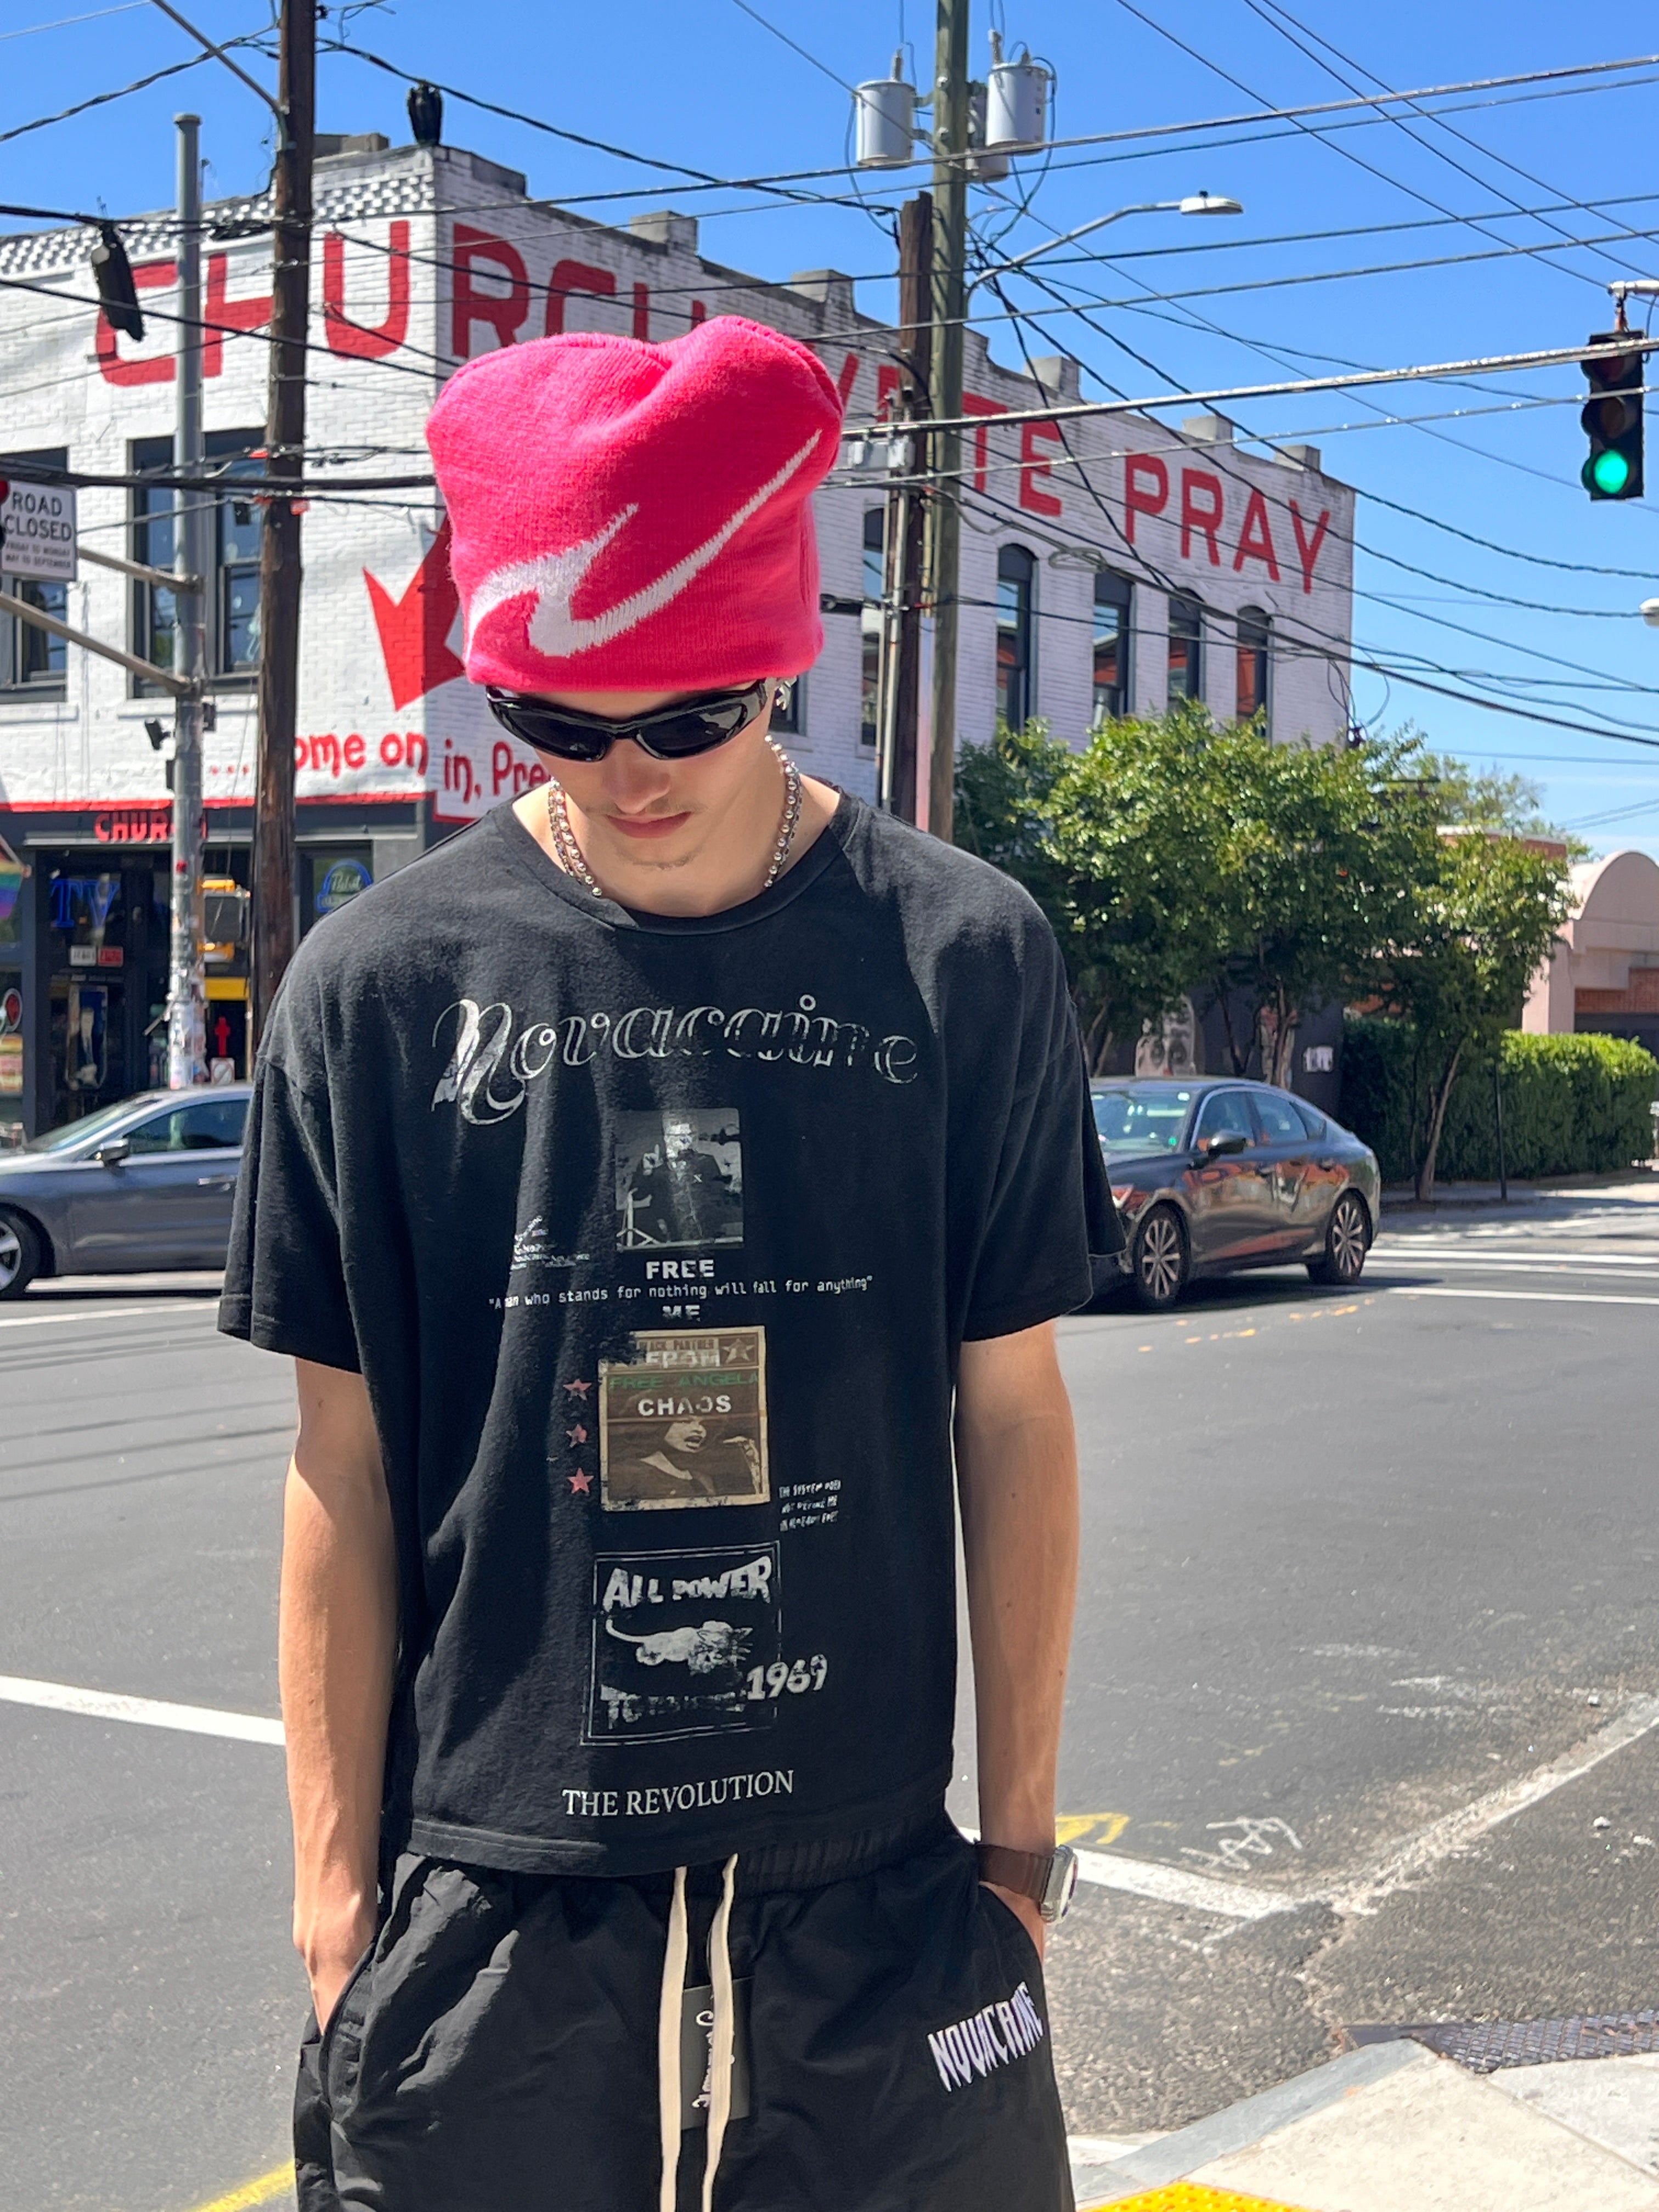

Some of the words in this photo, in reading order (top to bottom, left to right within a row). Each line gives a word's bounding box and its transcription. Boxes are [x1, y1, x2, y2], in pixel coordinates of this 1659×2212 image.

[12, 492, 62, 517] ROAD
[4, 514, 72, 541] CLOSED
[1125, 447, 1330, 595] PRAY
[295, 733, 365, 777] ome
[380, 733, 428, 776] on
[444, 738, 481, 803] in,
[493, 741, 553, 795] Pre
[95, 811, 206, 842] CHUR
[646, 1259, 714, 1279] FREE
[525, 1293, 550, 1306] who
[558, 1288, 608, 1303] stands
[617, 1286, 641, 1299] for
[649, 1284, 707, 1300] nothing
[714, 1282, 746, 1295] will
[753, 1280, 776, 1293] fall
[786, 1280, 809, 1292] for
[609, 1376, 663, 1390] FREE
[678, 1373, 758, 1387] ANGELA
[638, 1395, 731, 1416] CHAOS
[672, 1555, 771, 1604] POWER
[747, 1654, 828, 1700] 1969
[562, 1789, 618, 1816] THE
[626, 1770, 794, 1815] REVOLUTION
